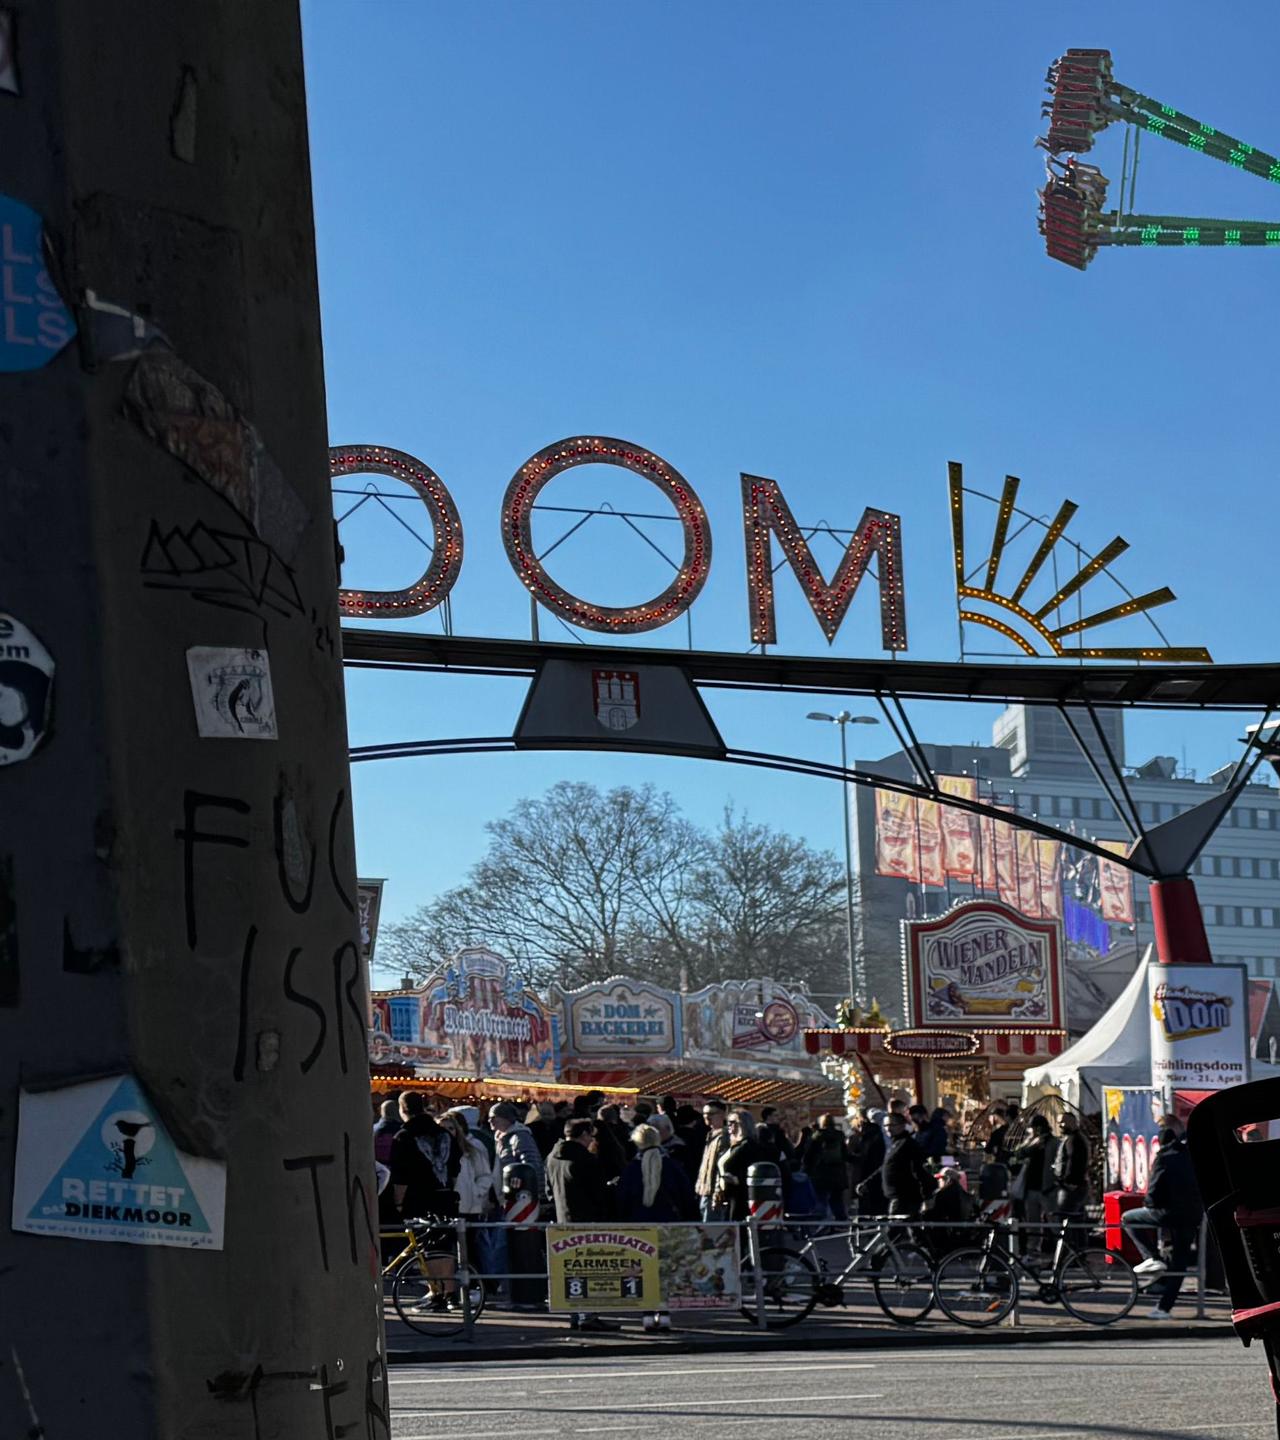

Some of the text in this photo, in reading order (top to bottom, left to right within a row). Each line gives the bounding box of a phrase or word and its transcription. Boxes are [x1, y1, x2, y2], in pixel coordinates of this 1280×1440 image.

[328, 434, 908, 652] DOM
[936, 928, 1009, 971] WIENER
[960, 940, 1043, 986] MANDELN
[603, 1004, 642, 1019] DOM
[61, 1177, 186, 1209] RETTET
[64, 1203, 193, 1227] DIEKMOOR
[552, 1233, 656, 1258] KASPERTHEATER
[564, 1259, 641, 1269] FARMSEN
[569, 1281, 583, 1296] 8
[625, 1279, 637, 1295] 1
